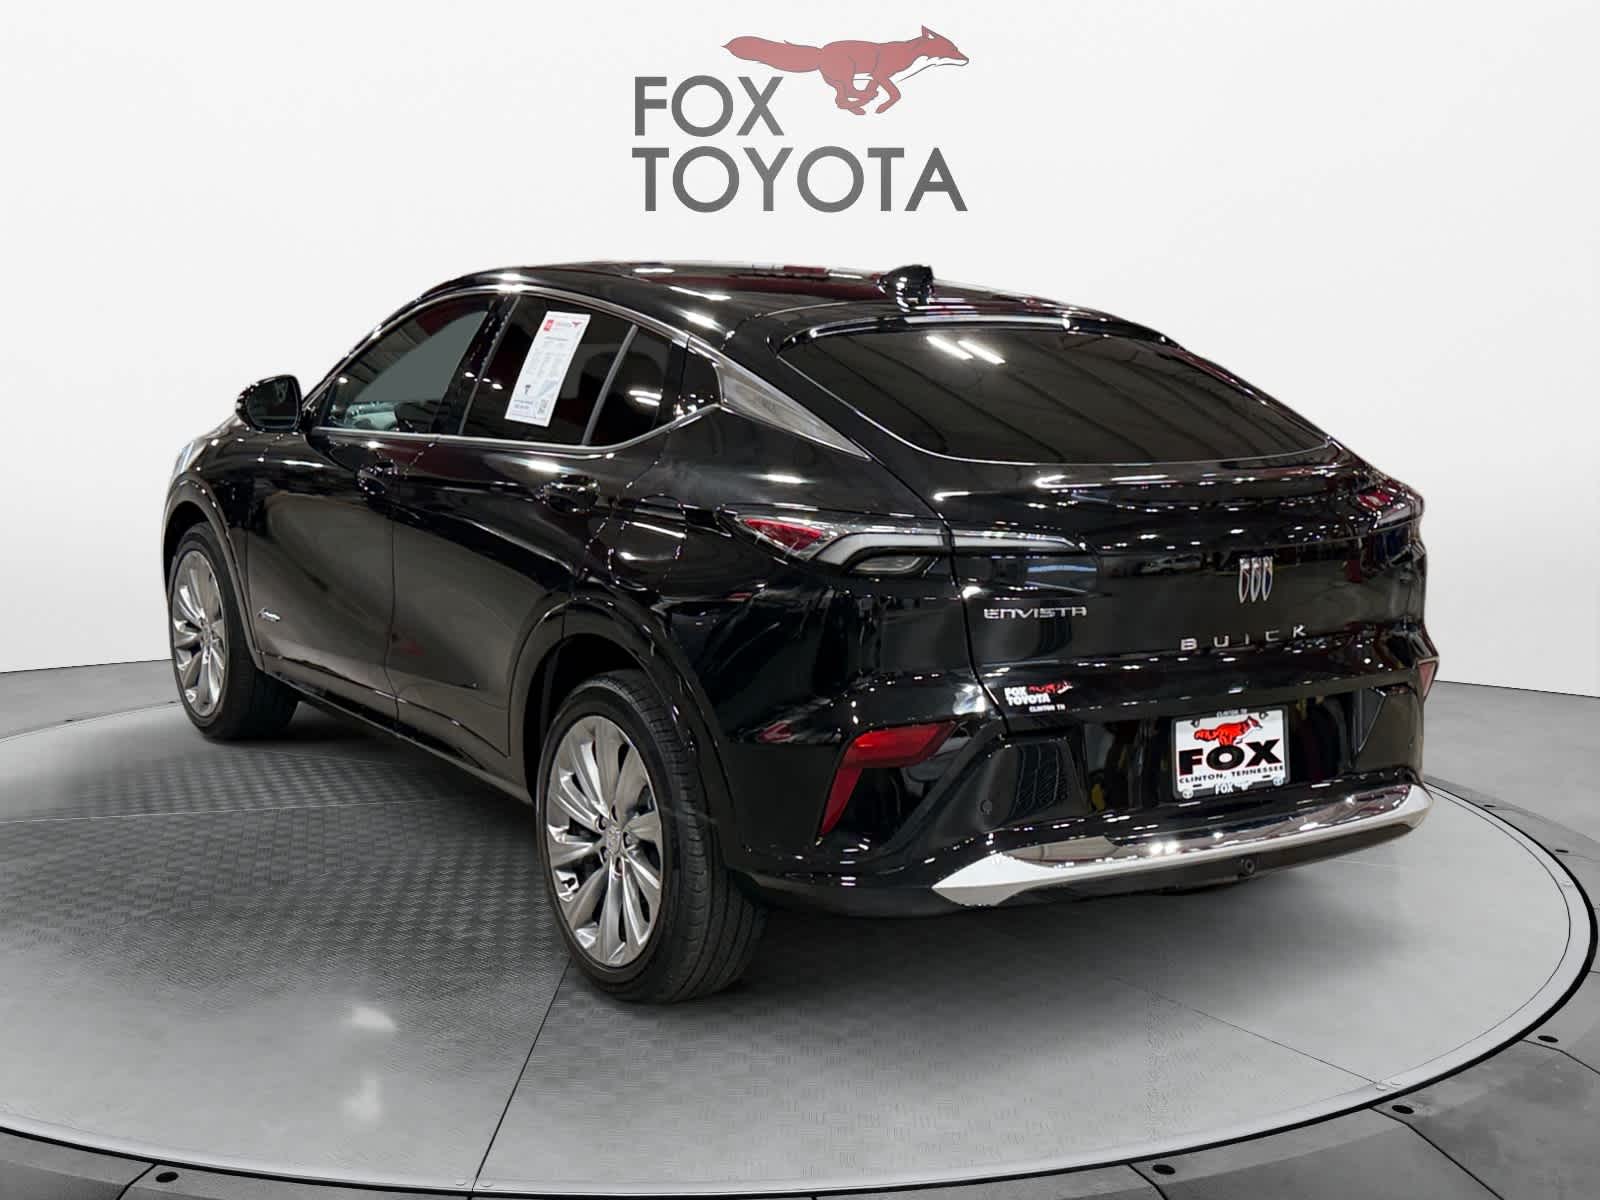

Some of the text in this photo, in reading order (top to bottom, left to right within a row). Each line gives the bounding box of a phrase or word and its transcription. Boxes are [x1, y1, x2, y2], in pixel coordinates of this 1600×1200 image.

[983, 606, 1087, 619] ENVISTA
[1180, 624, 1306, 651] BUICK
[1007, 693, 1051, 706] TOYOTA
[1178, 738, 1282, 777] FOX
[1179, 765, 1284, 784] CLINTON, TENNESSEE
